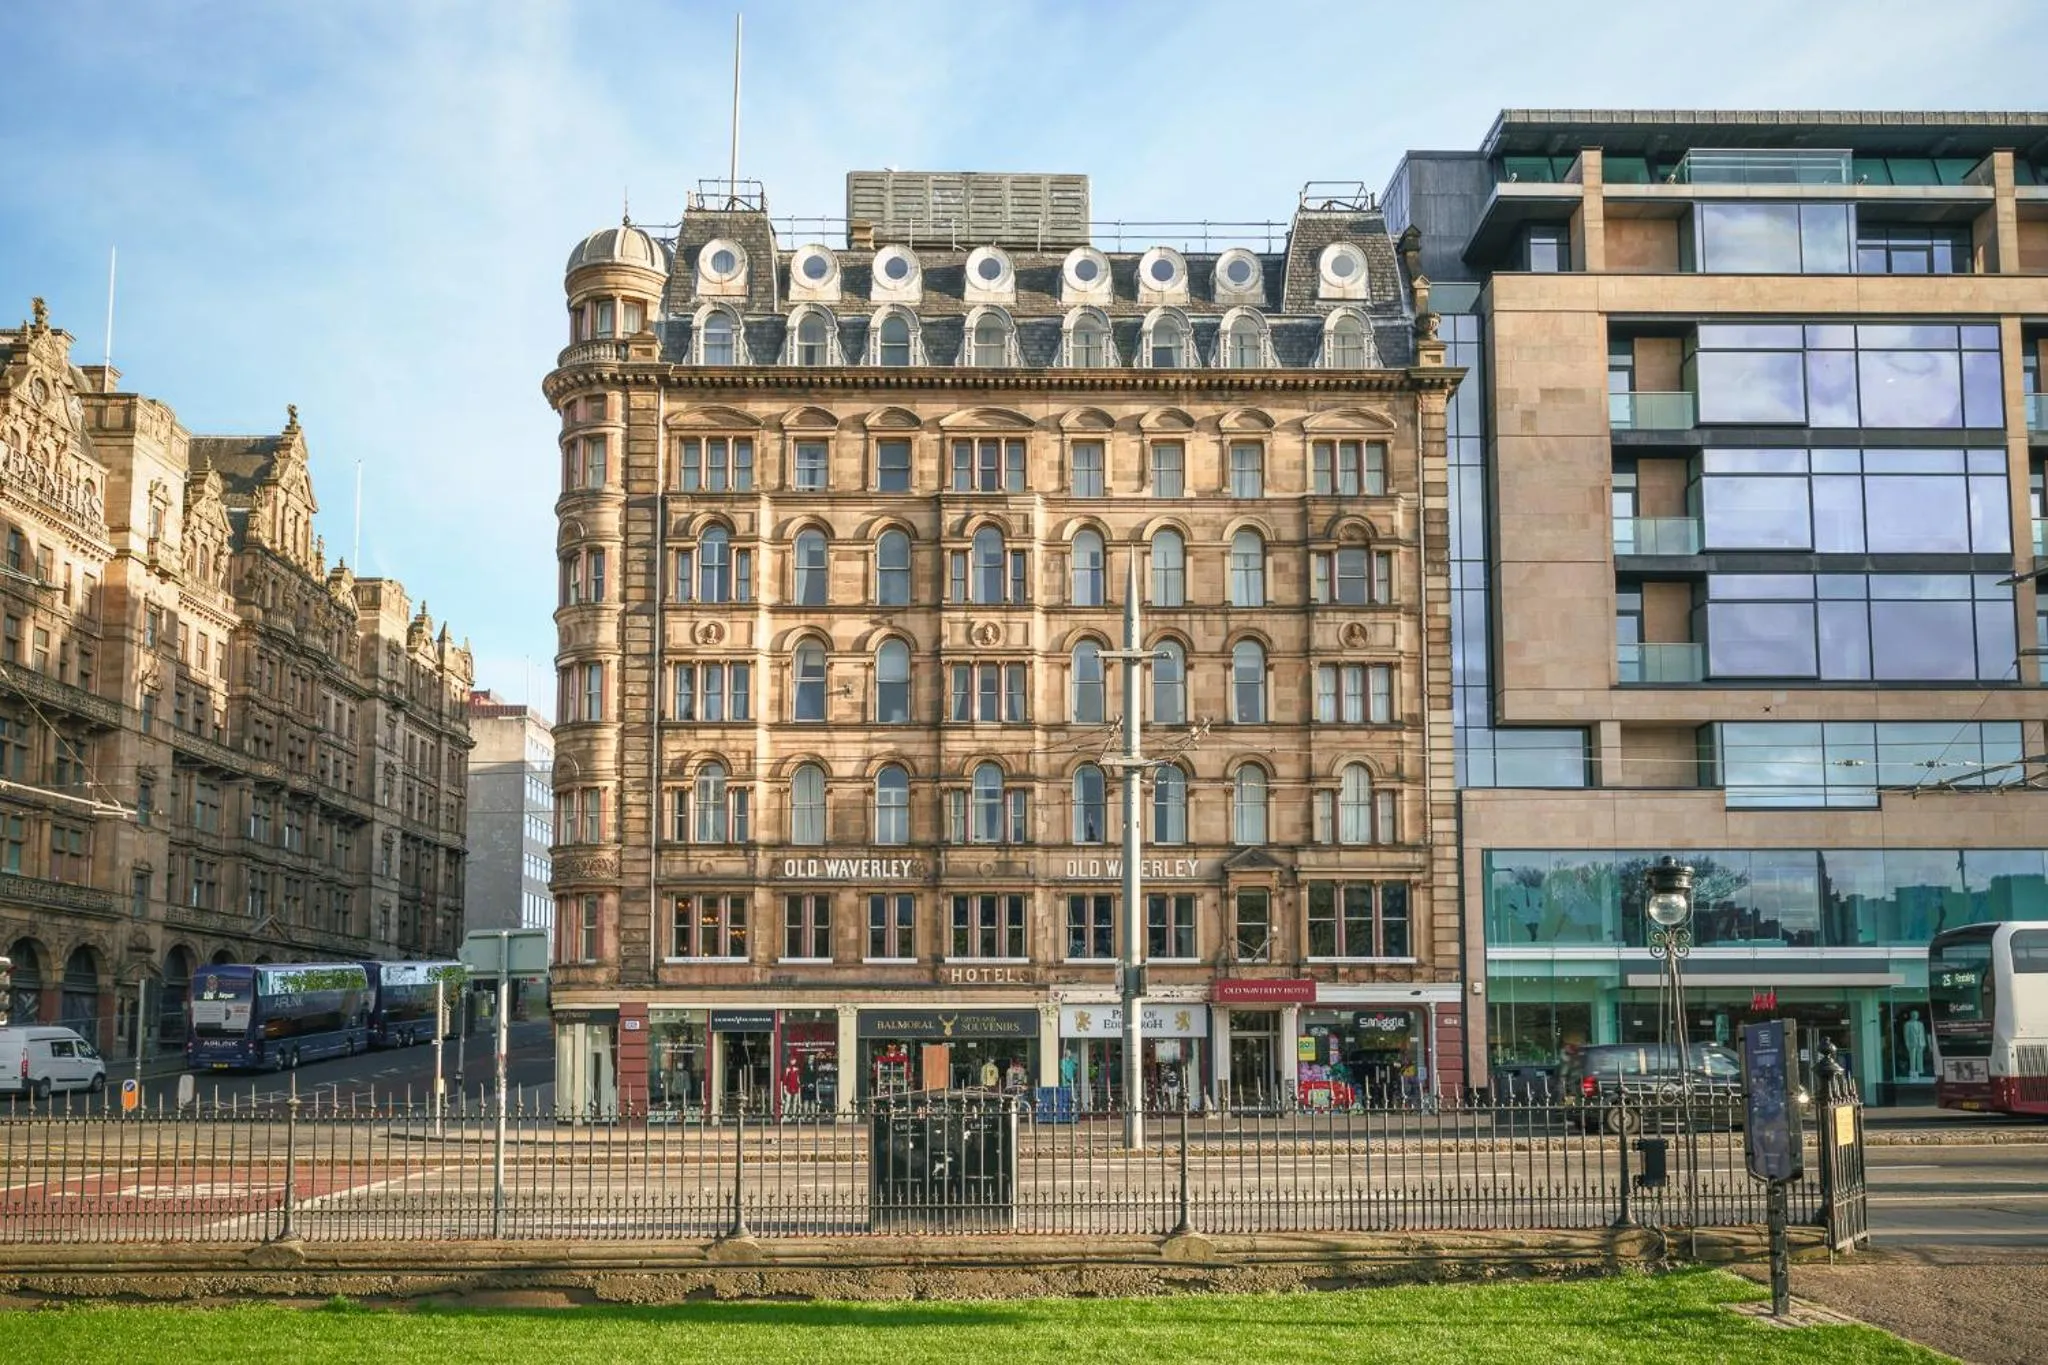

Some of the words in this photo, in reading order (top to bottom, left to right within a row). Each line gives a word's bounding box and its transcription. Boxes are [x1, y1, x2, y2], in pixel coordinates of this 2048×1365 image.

[2, 443, 103, 524] ENNERS
[784, 859, 818, 878] OLD
[824, 859, 912, 878] WAVERLEY
[1066, 859, 1100, 878] OLD
[1106, 859, 1199, 878] WERLEY
[1224, 987, 1242, 995] OLD
[1243, 987, 1282, 995] WAVERLEY
[877, 1019, 935, 1030] BALMORAL
[961, 1021, 1020, 1032] SOUVENIRS
[203, 1040, 239, 1048] AIRLINK
